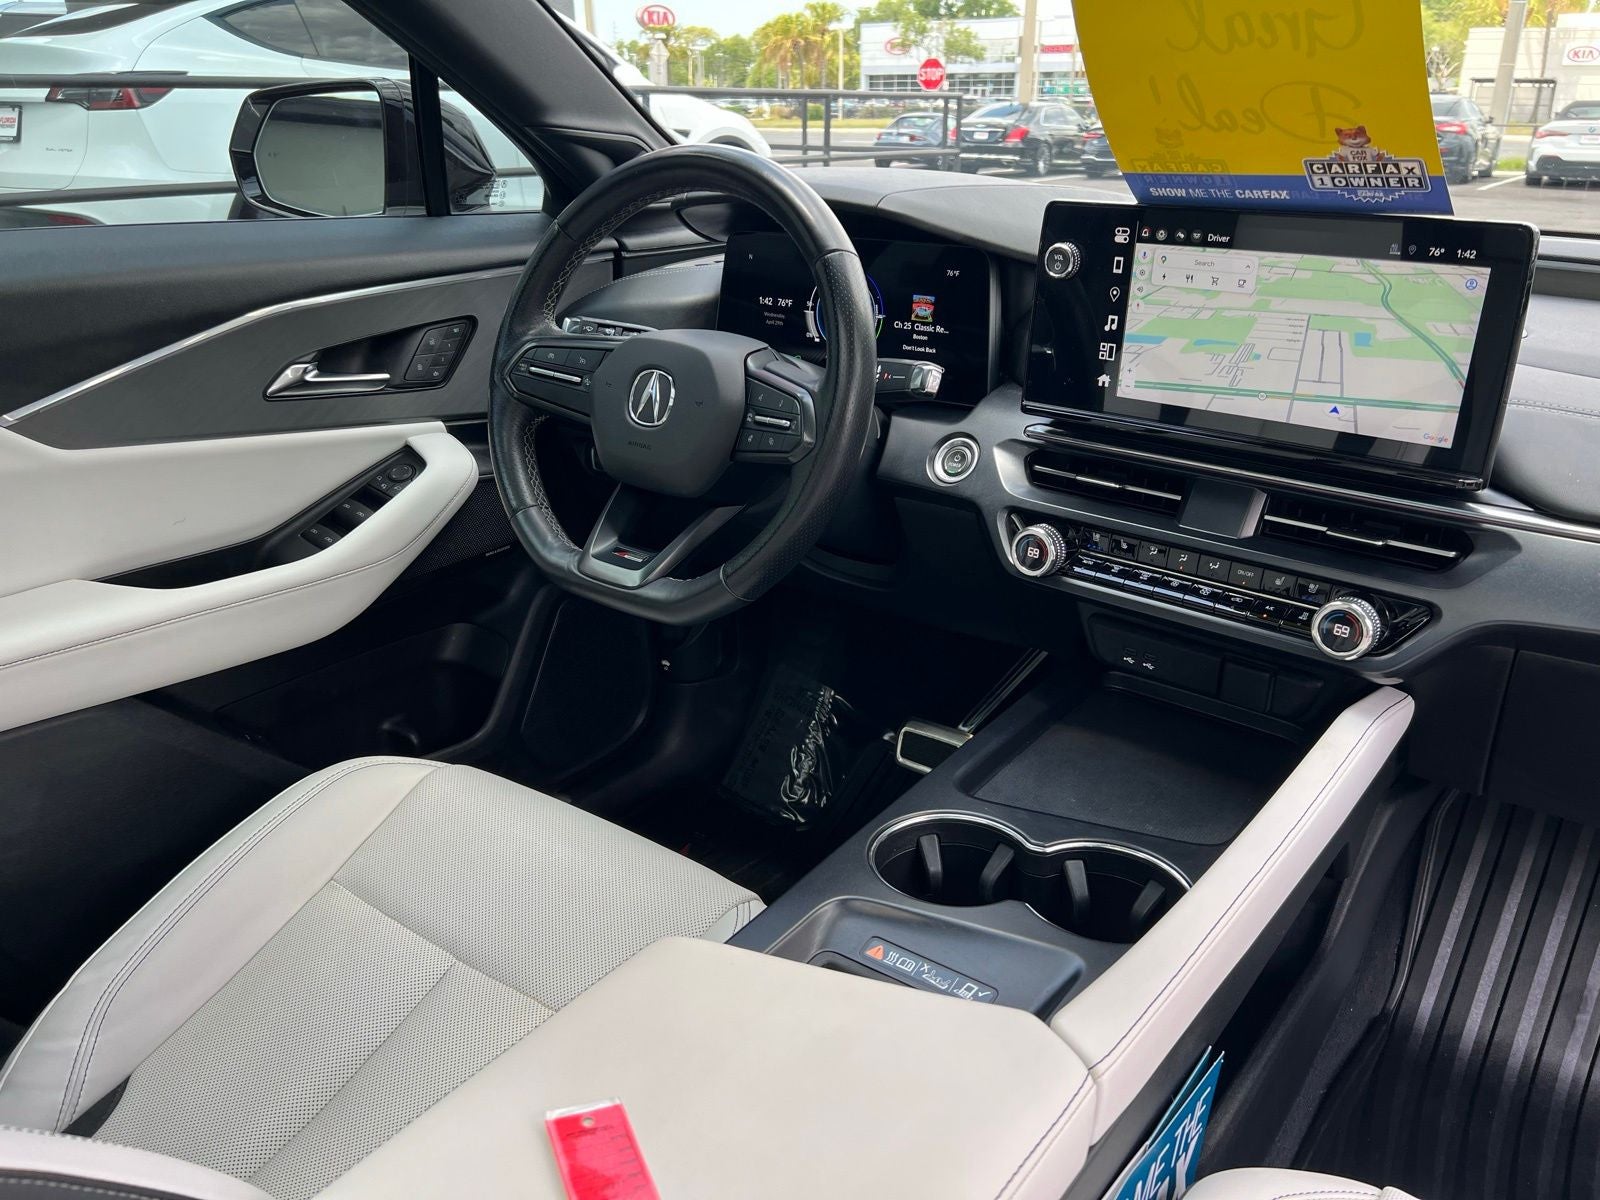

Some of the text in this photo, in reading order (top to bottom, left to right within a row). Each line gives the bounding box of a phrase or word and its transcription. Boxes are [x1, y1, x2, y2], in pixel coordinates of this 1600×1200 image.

[647, 10, 670, 25] KIA
[1572, 50, 1594, 59] KIA
[919, 67, 944, 81] STOP
[1311, 163, 1416, 176] CARFAX
[1317, 176, 1421, 188] 1 OWNER
[1150, 187, 1187, 197] SHOW
[1189, 189, 1207, 199] ME
[1209, 189, 1233, 199] THE
[1235, 189, 1290, 200] CARFAX
[1207, 233, 1231, 243] Driver
[1456, 249, 1477, 259] 1:42
[1194, 259, 1215, 268] Search
[759, 296, 793, 307] 1:42 76°F
[893, 321, 903, 329] Ch
[903, 322, 912, 330] 25
[914, 323, 935, 333] Classic
[912, 333, 928, 341] Boston
[902, 344, 914, 352] Don't
[1027, 546, 1040, 559] 69
[1237, 569, 1255, 578] ON/OFF
[1333, 623, 1350, 638] 69
[1171, 1086, 1211, 1168] THE
